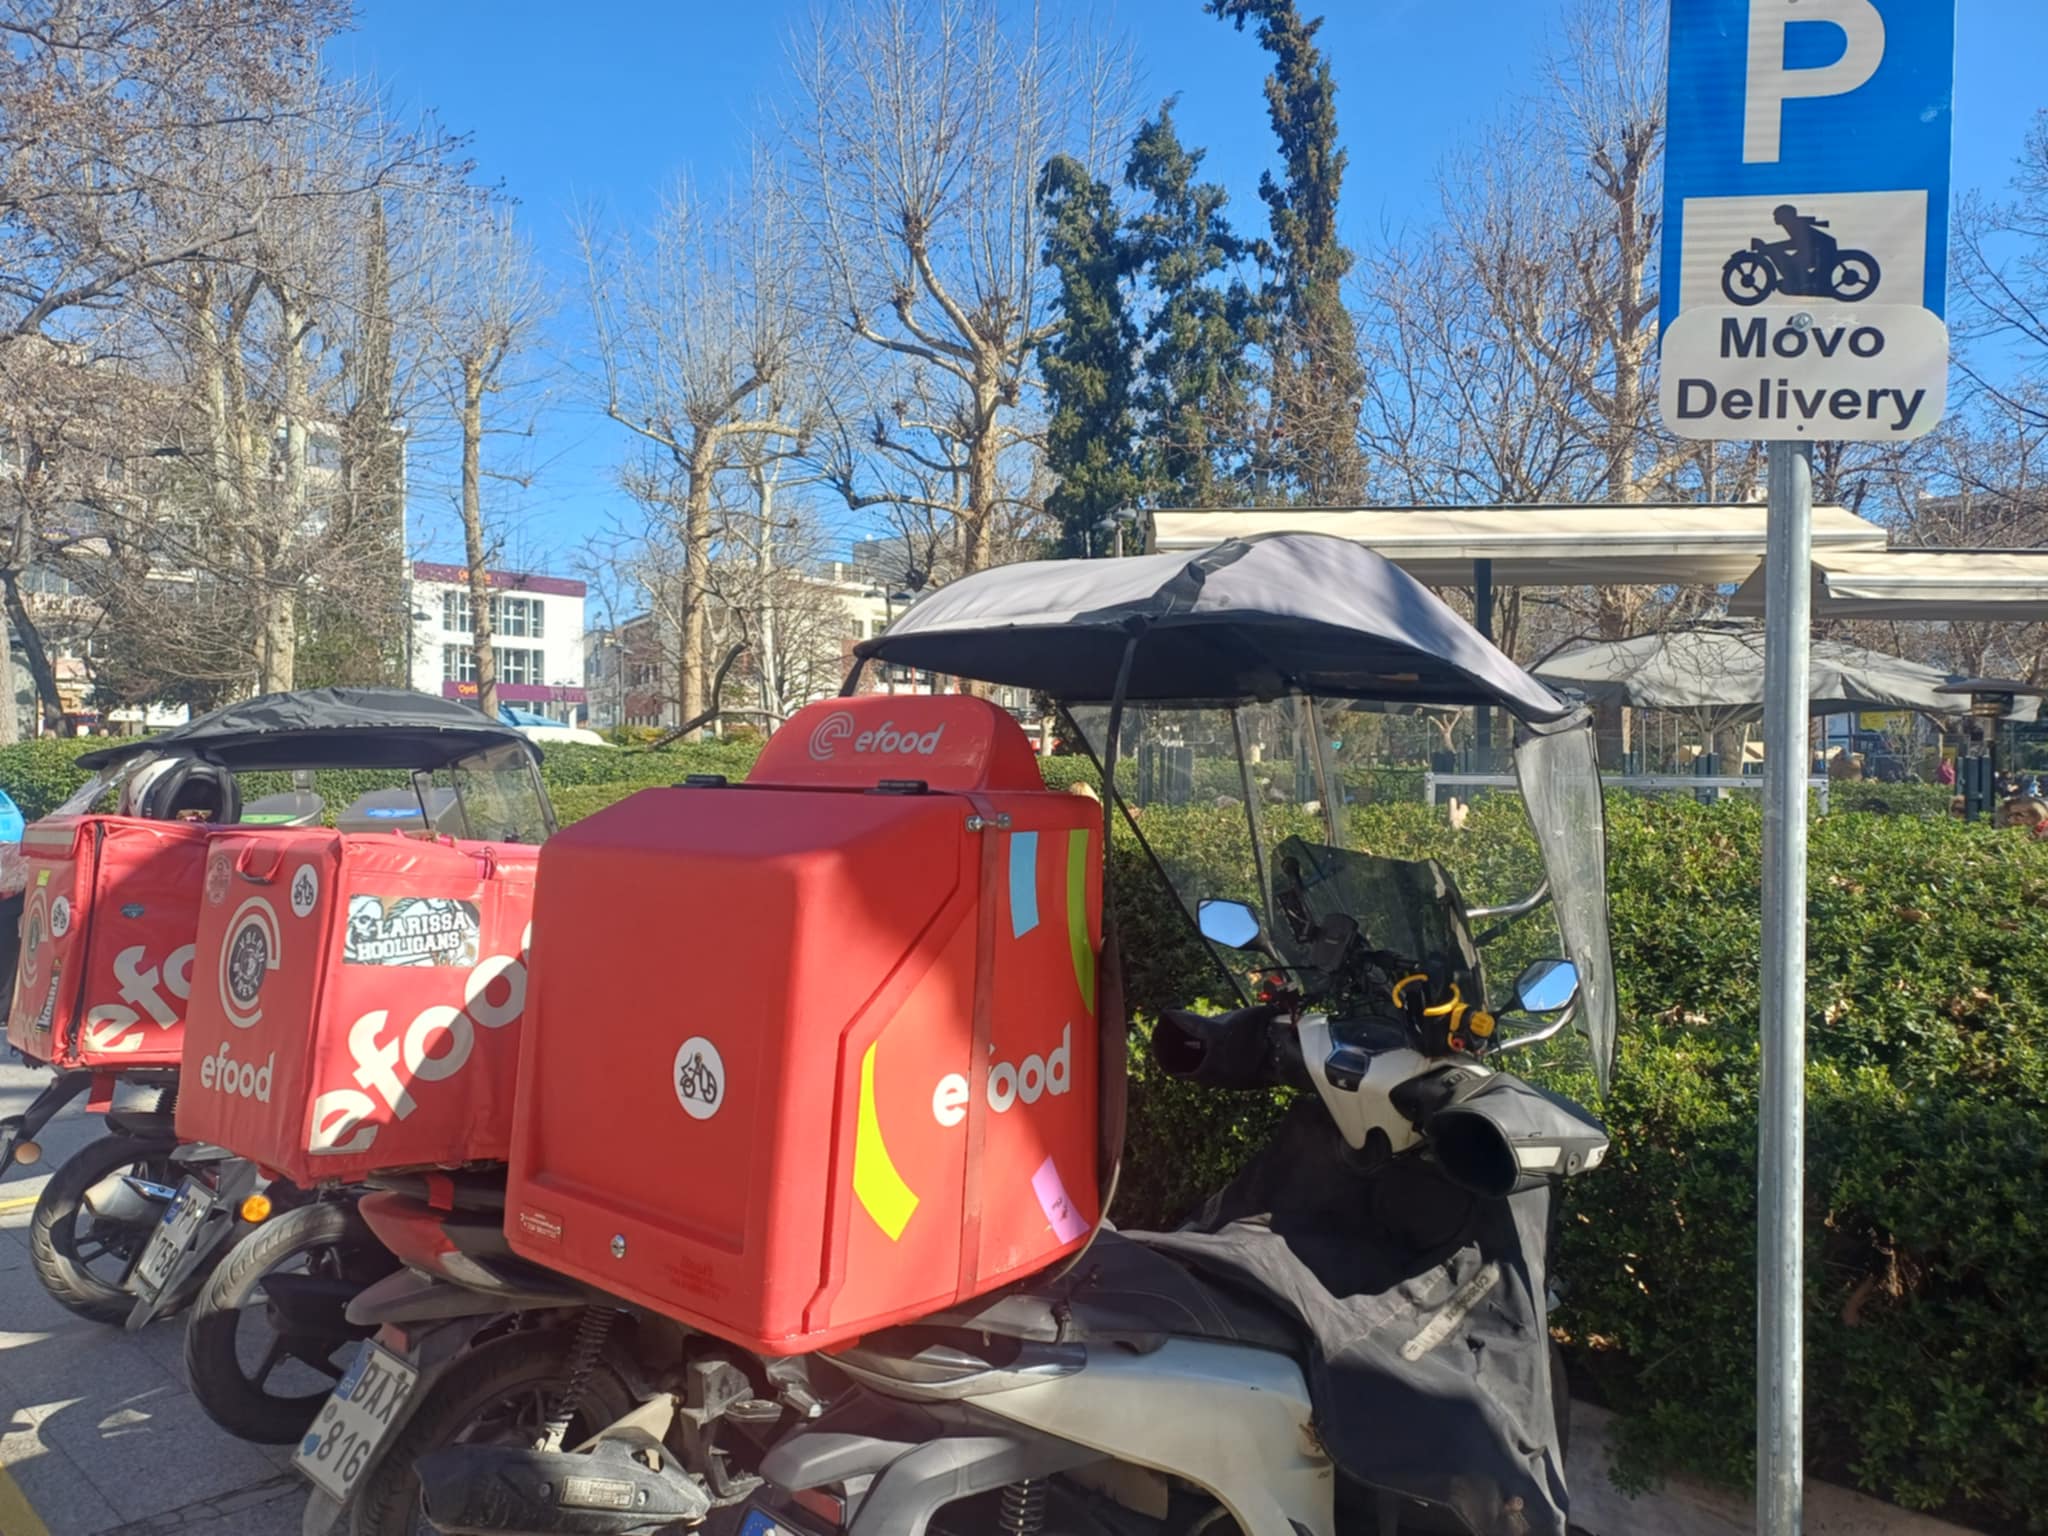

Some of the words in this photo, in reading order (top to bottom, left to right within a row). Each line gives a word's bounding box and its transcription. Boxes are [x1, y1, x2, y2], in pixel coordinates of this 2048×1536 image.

[1743, 0, 1886, 163] P
[1677, 377, 1927, 431] Delivery
[855, 720, 945, 755] efood
[357, 931, 460, 961] HOOLIGANS
[375, 911, 468, 940] LARISSA
[84, 943, 197, 1054] efo
[309, 920, 533, 1155] efoo
[200, 1041, 275, 1103] efood
[932, 1021, 1071, 1128] eood
[351, 1361, 410, 1425] BAX
[316, 1419, 371, 1483] 816
